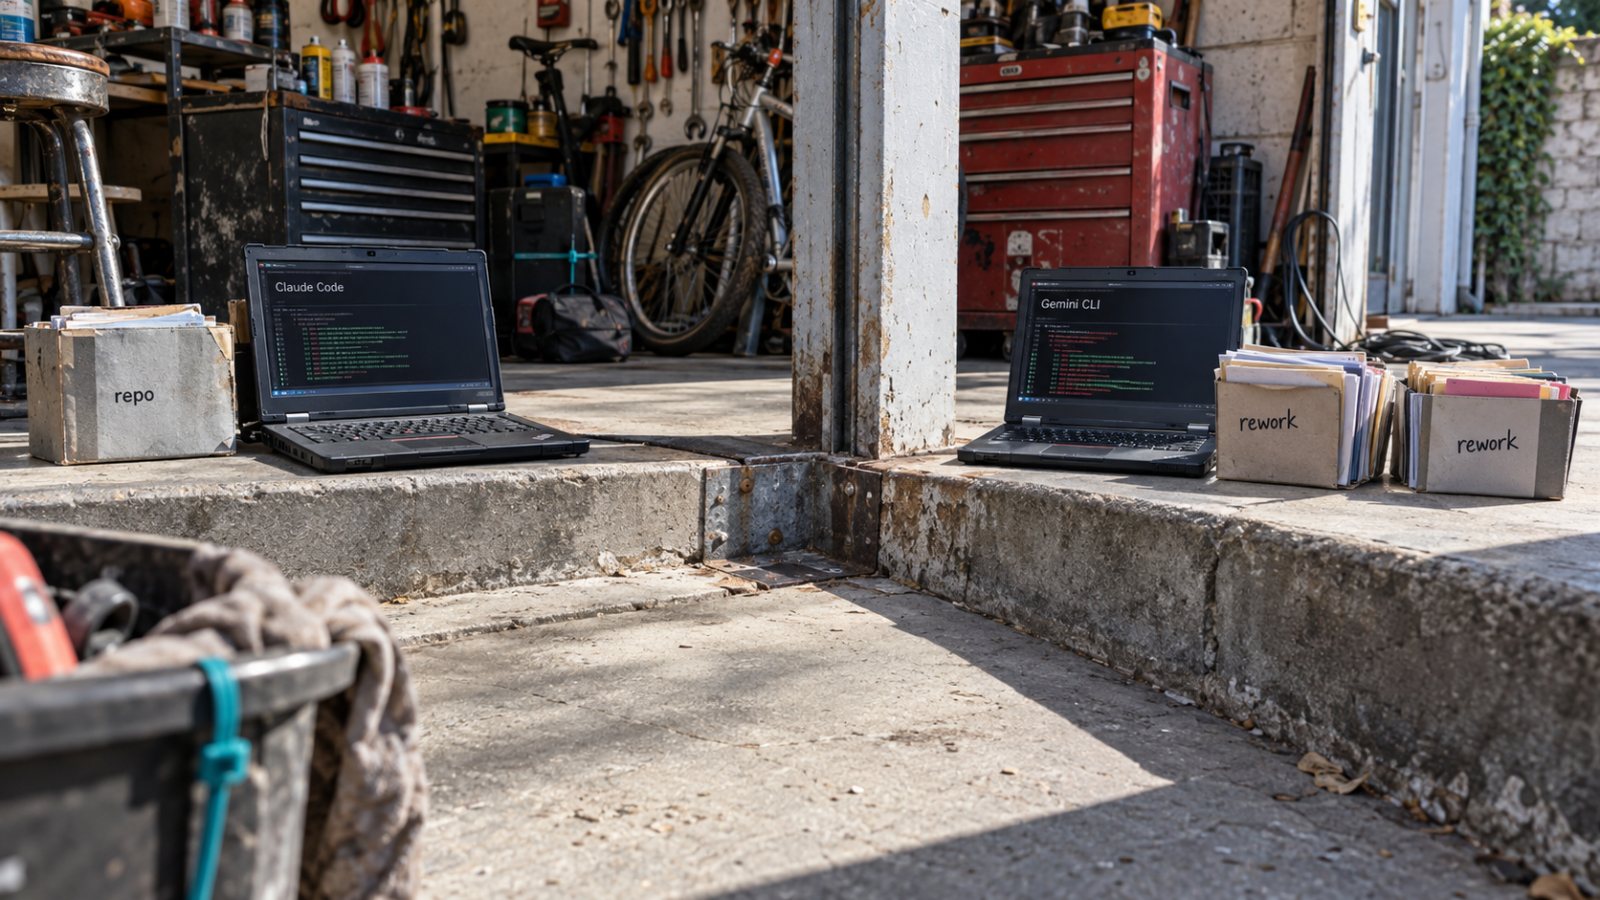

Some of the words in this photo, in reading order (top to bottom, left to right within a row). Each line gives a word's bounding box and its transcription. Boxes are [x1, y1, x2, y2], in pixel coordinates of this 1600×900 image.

[275, 281, 313, 292] Claude
[316, 281, 344, 292] Code
[1041, 298, 1079, 310] Gemini
[1082, 298, 1101, 310] CLI
[114, 389, 155, 406] repo
[1239, 408, 1298, 431] rework
[1457, 429, 1519, 453] rework
